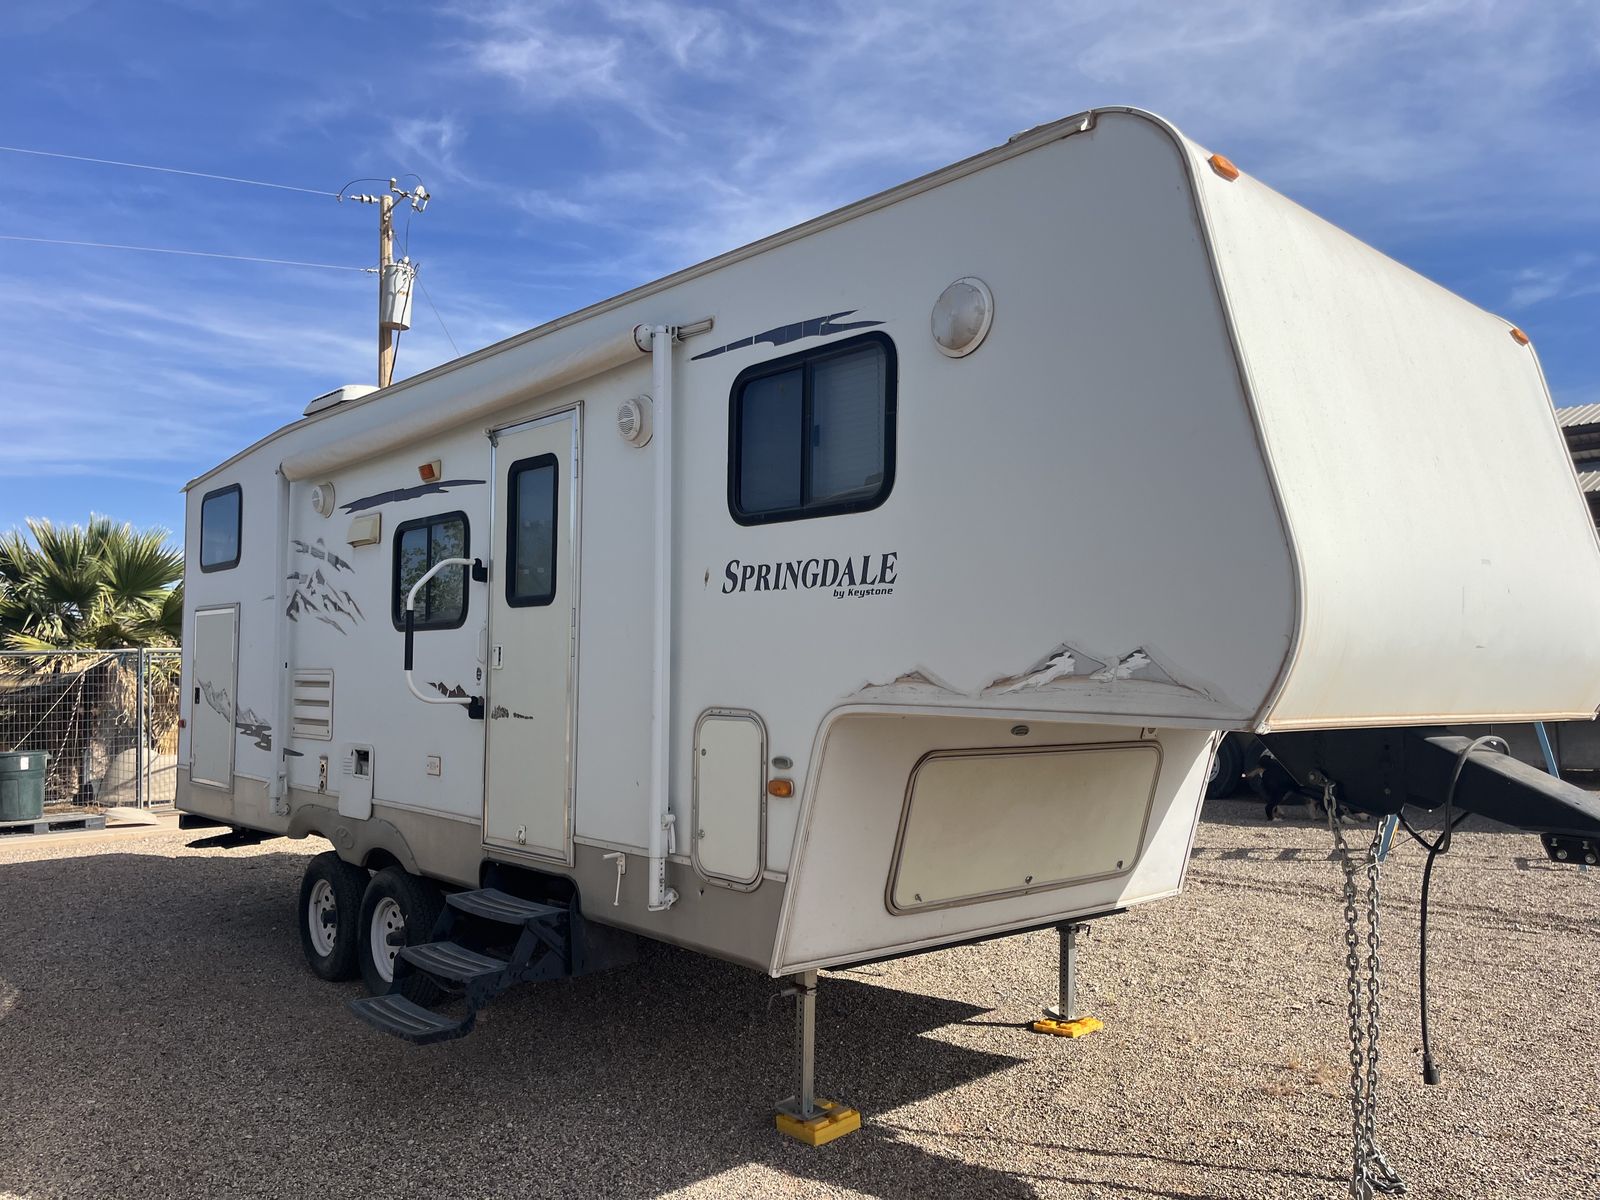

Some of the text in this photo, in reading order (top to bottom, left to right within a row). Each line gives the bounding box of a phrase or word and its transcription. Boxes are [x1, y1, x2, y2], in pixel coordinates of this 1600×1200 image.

[722, 552, 898, 594] SPRINGDALE
[832, 587, 894, 600] by Keystone
